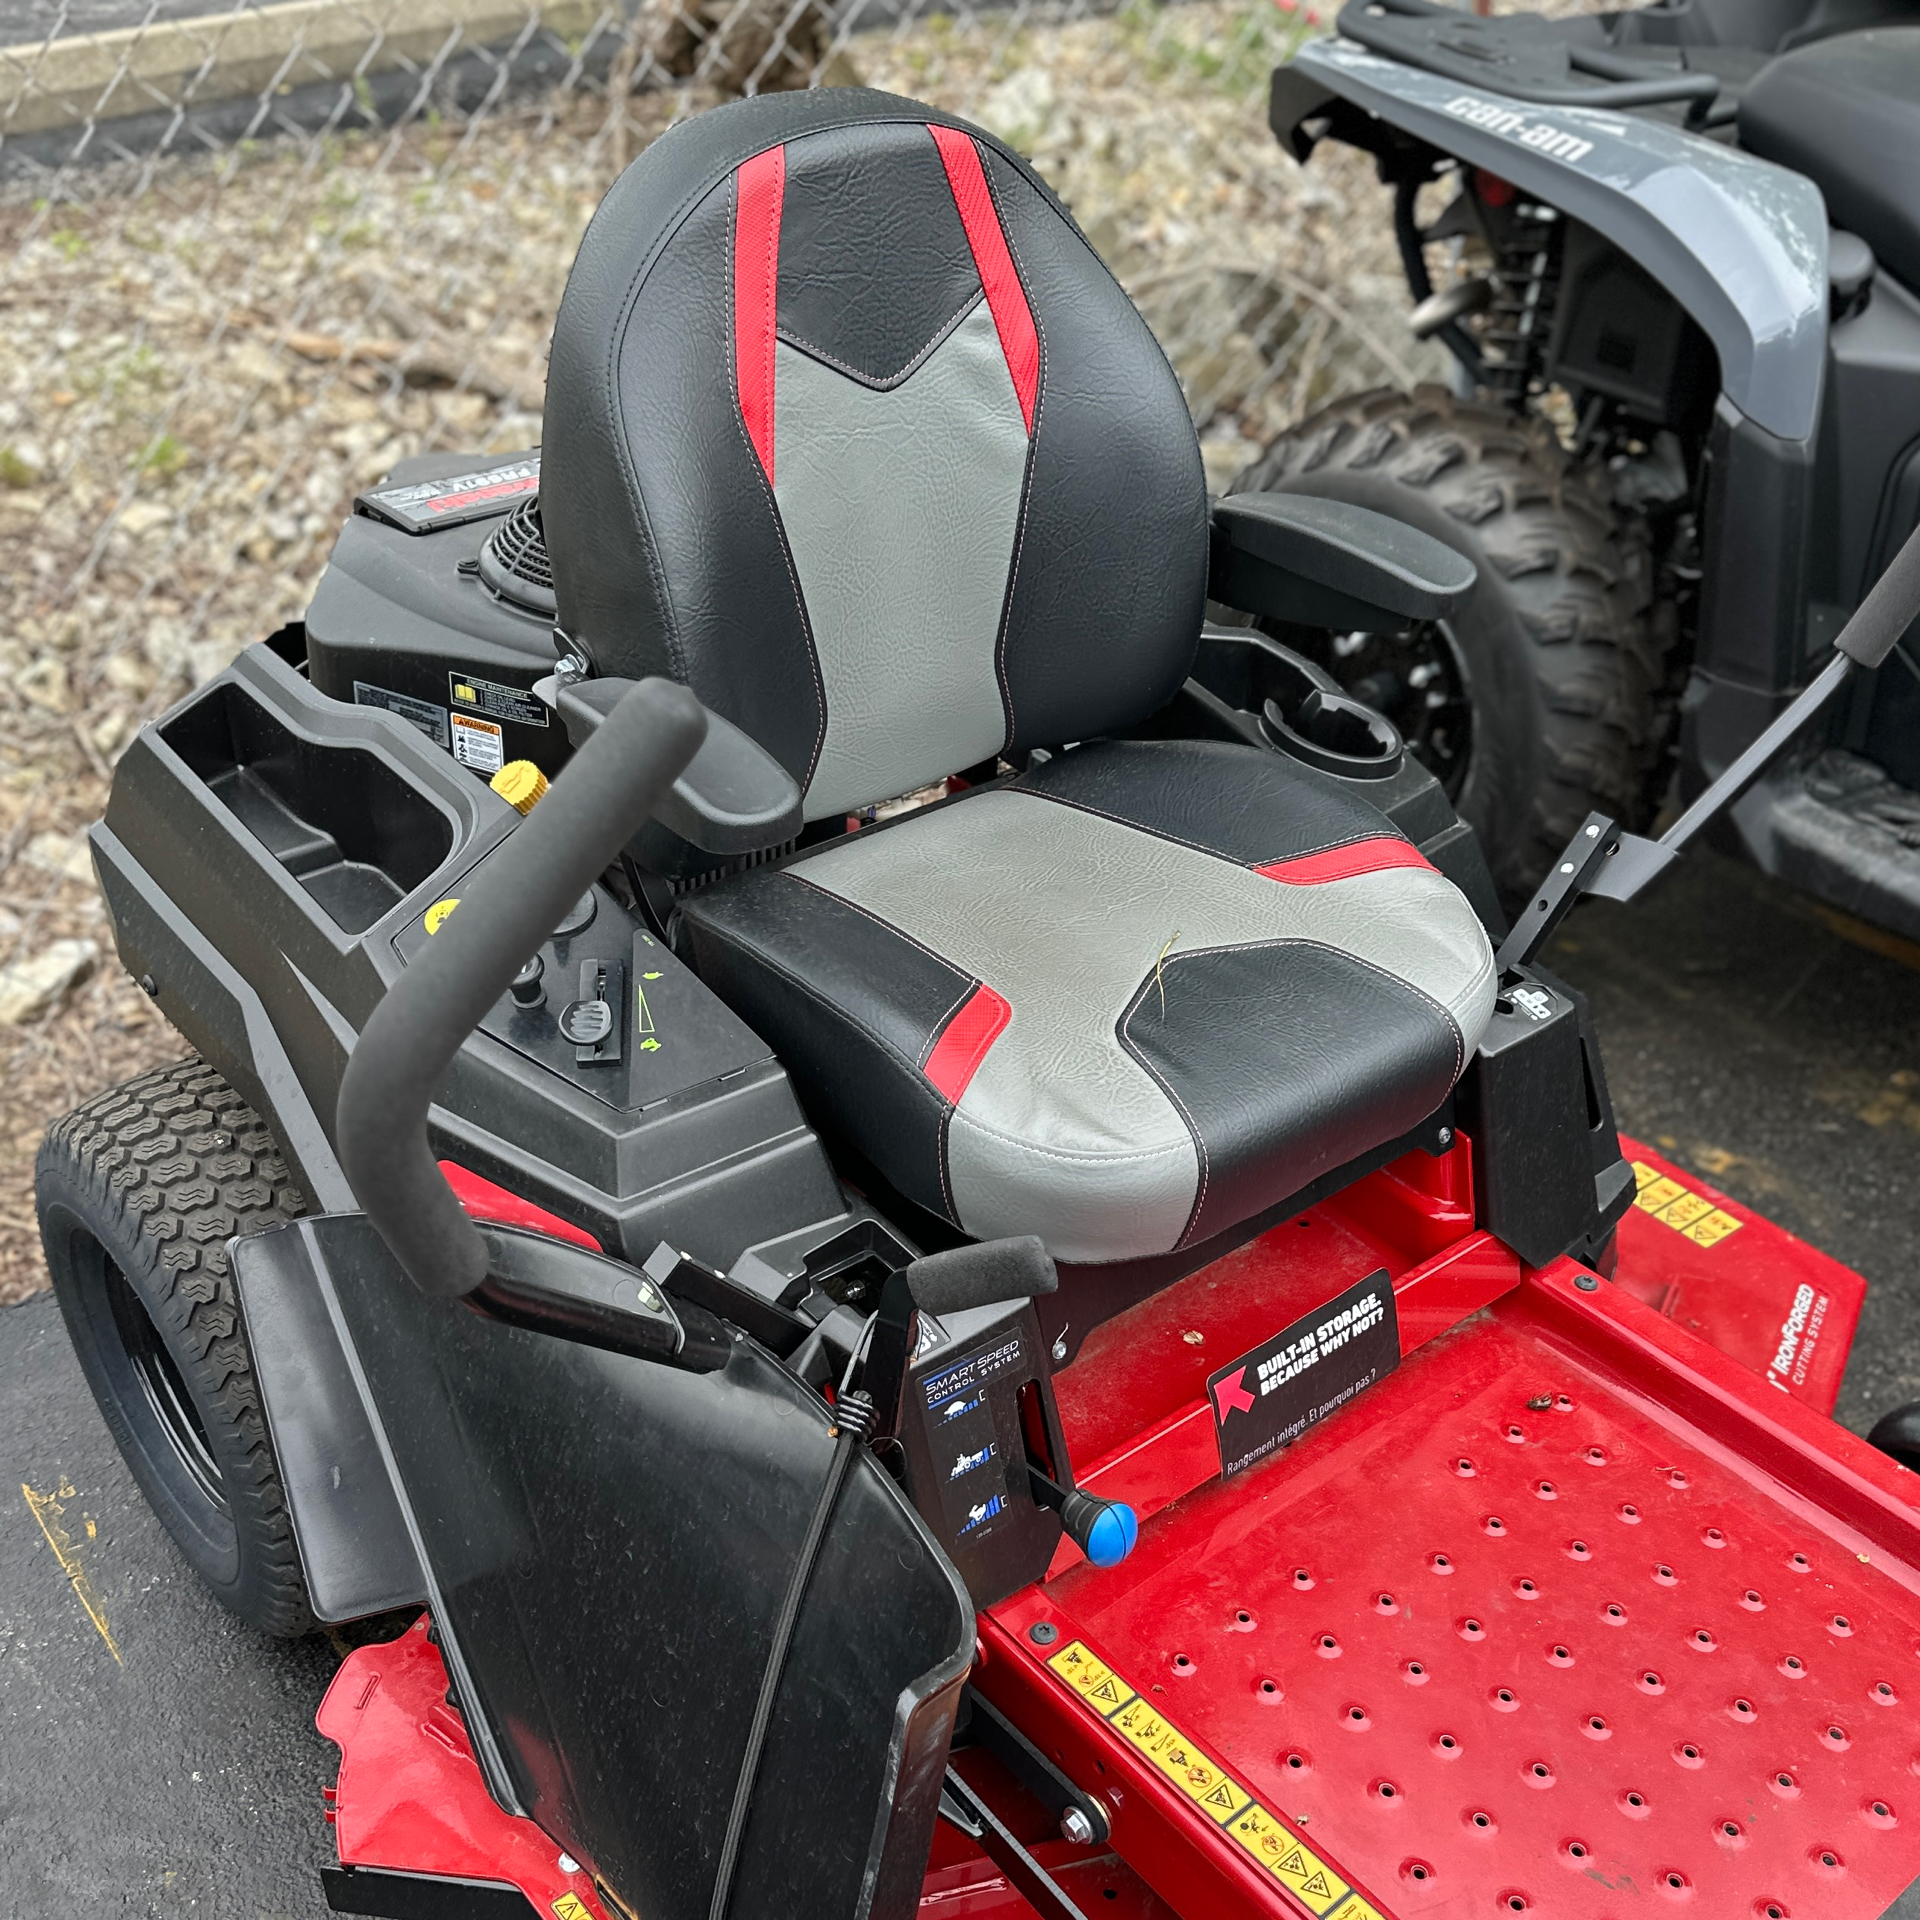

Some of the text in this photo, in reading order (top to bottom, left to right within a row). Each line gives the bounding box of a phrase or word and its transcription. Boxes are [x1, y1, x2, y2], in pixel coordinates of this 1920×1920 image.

[1443, 95, 1595, 162] can-am
[927, 1350, 1021, 1404] CONTROL SYSTEM
[1257, 1292, 1382, 1381] BUILT-IN STORAGE.
[1260, 1306, 1384, 1396] BECAUSE WHY NOT?
[1792, 1295, 1829, 1386] CUTTING SYSTEM
[1227, 1437, 1276, 1475] Rangement
[1277, 1414, 1309, 1444] intégré.
[1309, 1408, 1318, 1423] Et
[1319, 1382, 1354, 1418] pourquoi
[1355, 1374, 1370, 1394] pas
